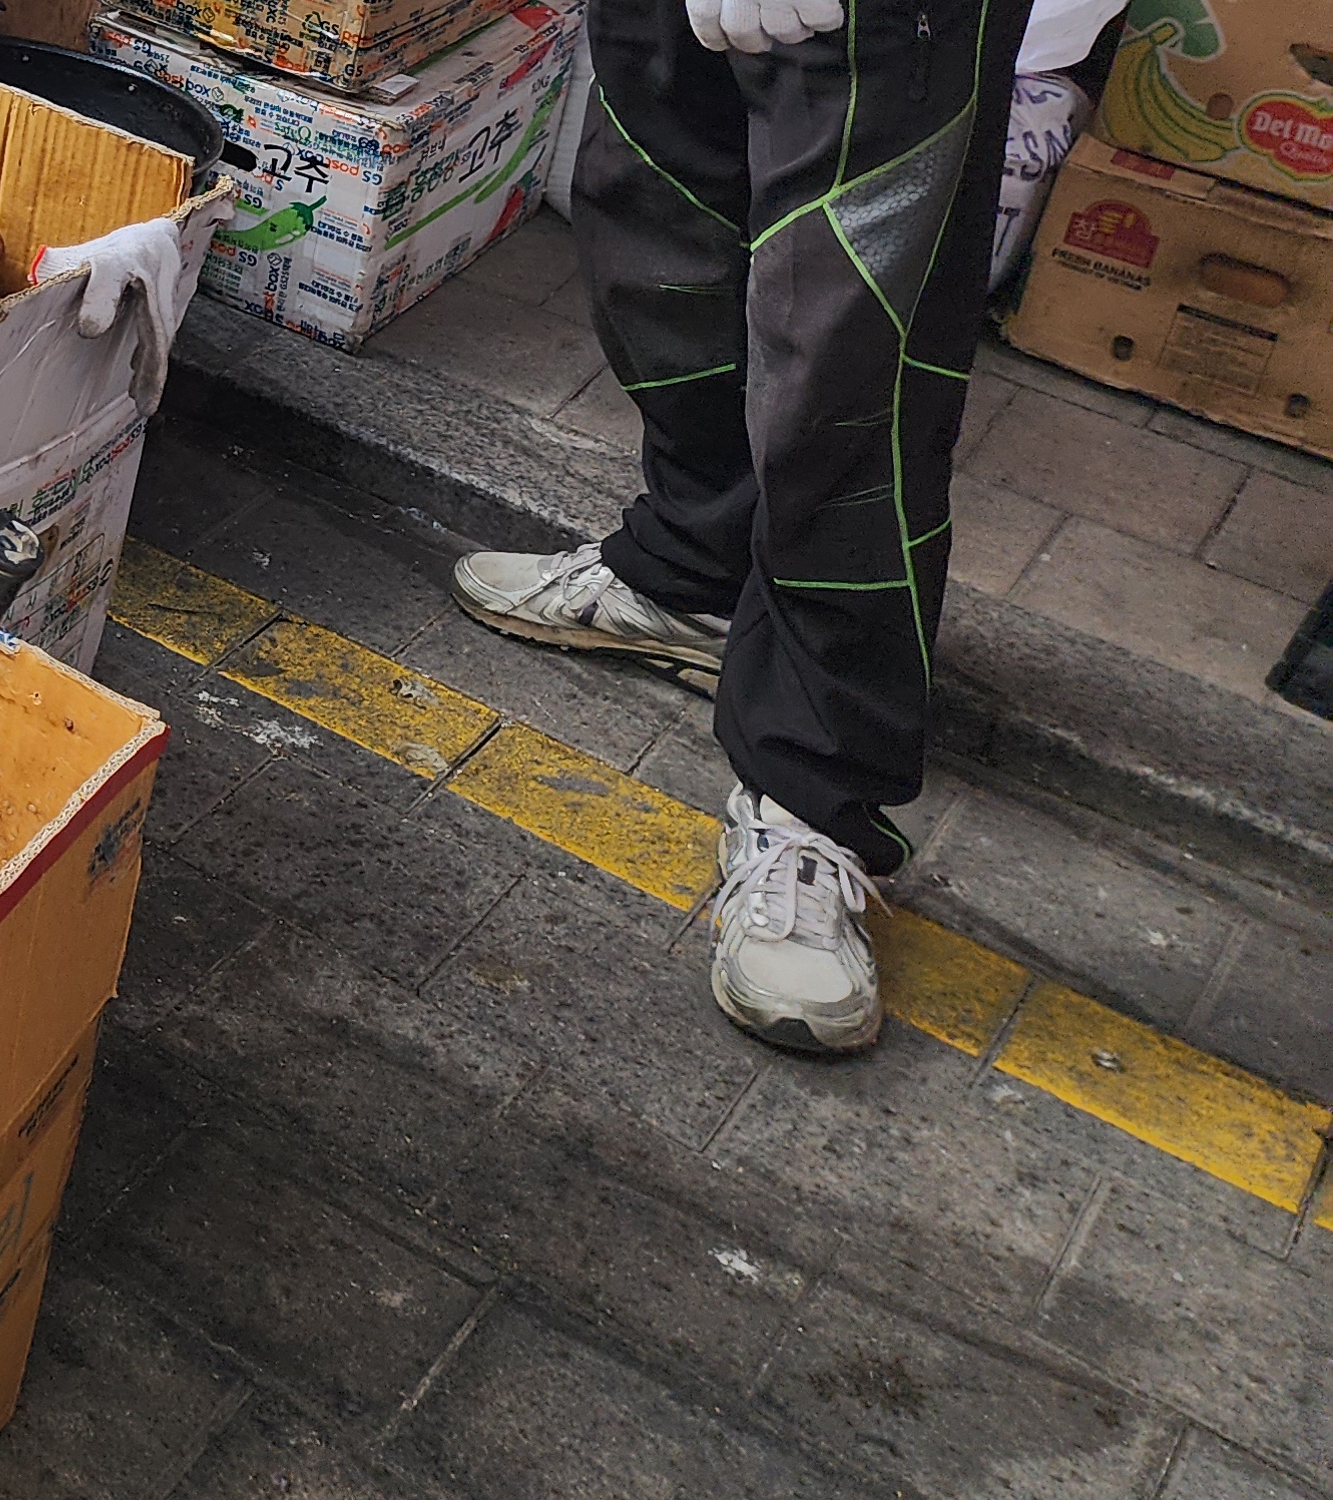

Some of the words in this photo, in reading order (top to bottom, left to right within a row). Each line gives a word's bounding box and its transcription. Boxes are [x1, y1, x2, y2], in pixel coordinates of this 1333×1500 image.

[459, 109, 522, 184] 고추
[1254, 111, 1292, 140] Del
[1295, 122, 1333, 149] Mo
[262, 143, 330, 194] 고추
[1051, 247, 1092, 268] FRESH
[1092, 260, 1151, 288] BANANAS
